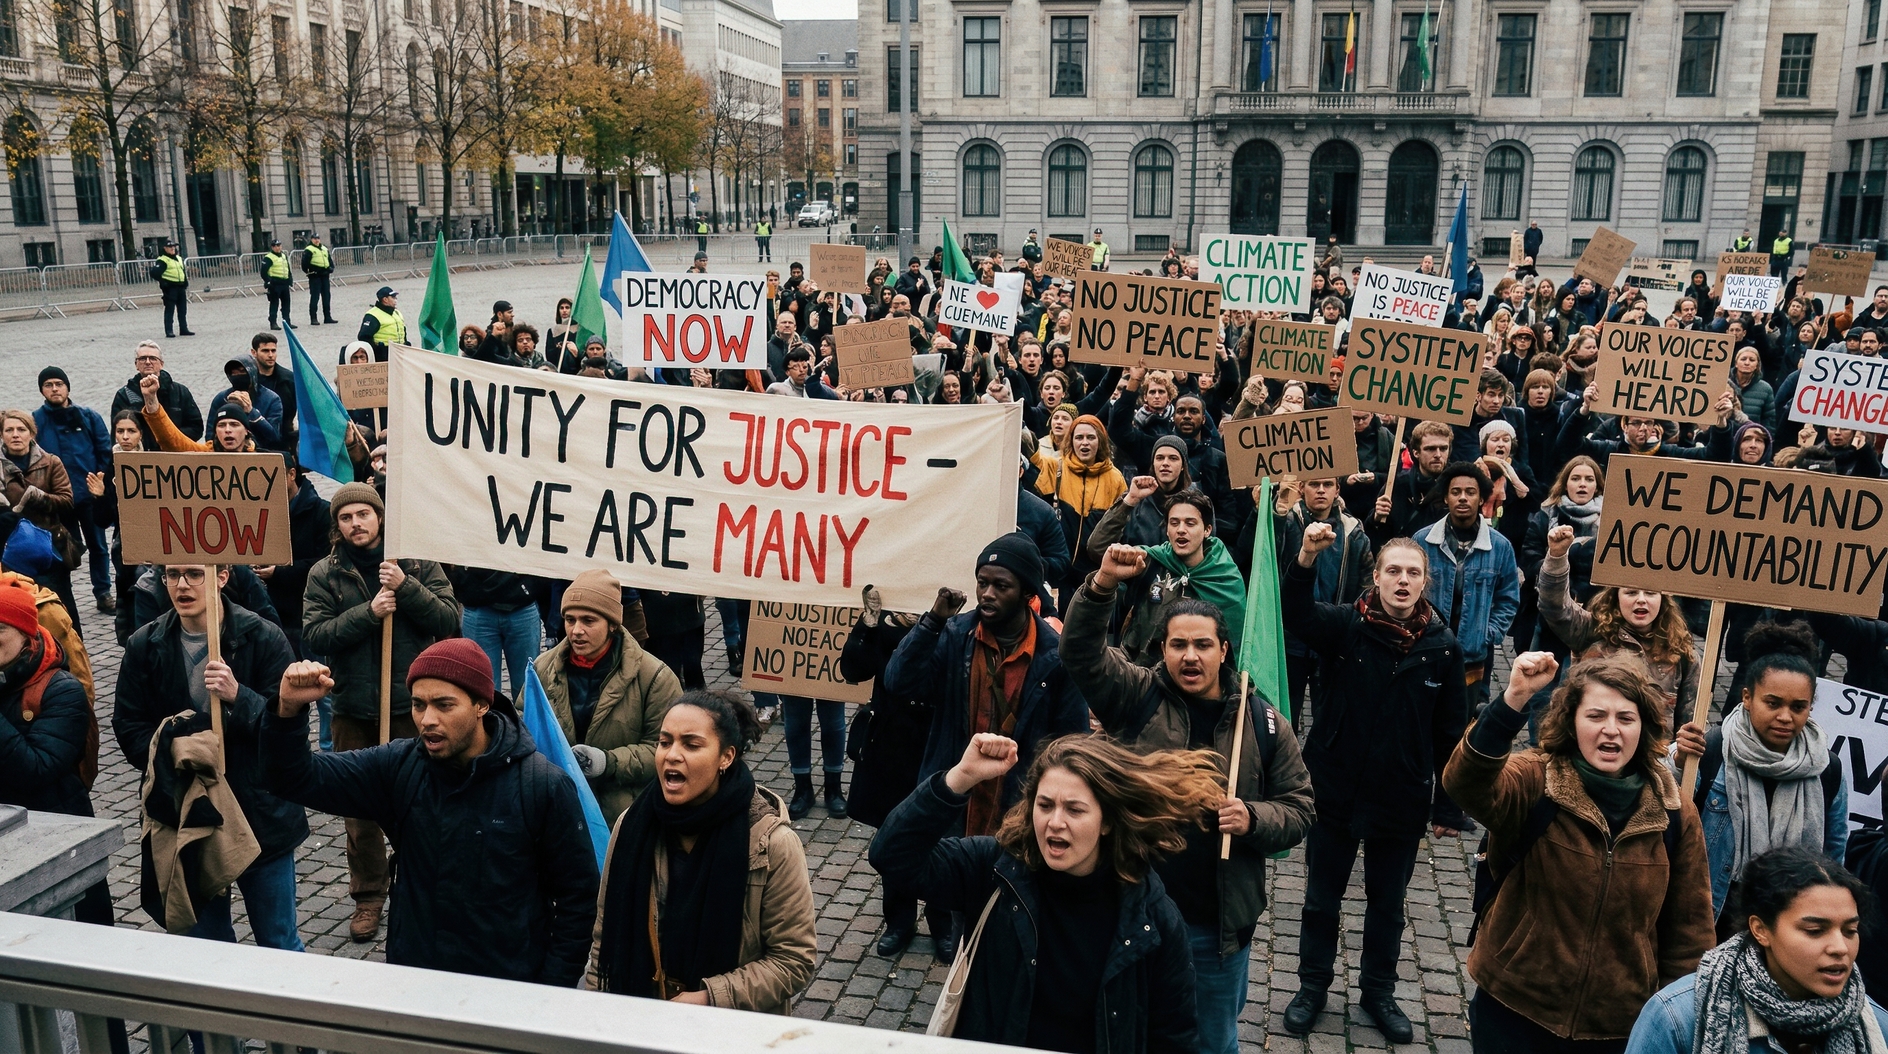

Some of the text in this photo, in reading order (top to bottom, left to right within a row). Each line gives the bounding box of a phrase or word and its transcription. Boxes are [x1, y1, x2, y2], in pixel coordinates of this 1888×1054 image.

[1046, 239, 1062, 252] WE
[1052, 252, 1072, 264] WILL
[1206, 239, 1308, 271] CLIMATE
[1044, 260, 1060, 274] OUR
[1726, 276, 1746, 286] OUR
[1748, 278, 1780, 289] VOICES
[627, 278, 764, 310] DEMOCRACY
[950, 285, 970, 304] NE
[1080, 279, 1118, 310] NO
[1214, 274, 1301, 306] ACTION
[1364, 272, 1450, 302] NO JUSTICE
[1728, 287, 1770, 300] WILL BE
[944, 305, 1008, 330] CUEMANE
[1372, 294, 1388, 310] IS
[1392, 296, 1440, 321] PEACE
[1730, 298, 1768, 310] HEARD
[643, 314, 754, 364] NOW
[1077, 318, 1210, 360] NO PEACE
[1259, 325, 1328, 350] CLIMATE
[1608, 329, 1729, 363] OUR VOICES
[1256, 348, 1326, 376] ACTION
[1622, 356, 1708, 385] WILL BE
[1348, 364, 1470, 415] CHANGE
[1612, 380, 1710, 418] HEARD
[424, 372, 587, 464] UNITY
[606, 399, 707, 478] FOR
[723, 411, 912, 501] JUSTICE
[1238, 416, 1330, 449] CLIMATE
[1255, 445, 1334, 477] ACTION
[120, 464, 278, 502] DEMOCRACY
[1625, 468, 1884, 532] WE DEMAND
[159, 506, 268, 556] NOW
[487, 475, 871, 588] WE ARE MANY
[1598, 519, 1888, 596] ACCOUNTABILITY
[757, 600, 860, 628] NO JUSTICE
[782, 626, 852, 650] NOEAC
[752, 646, 858, 686] NO PEAC
